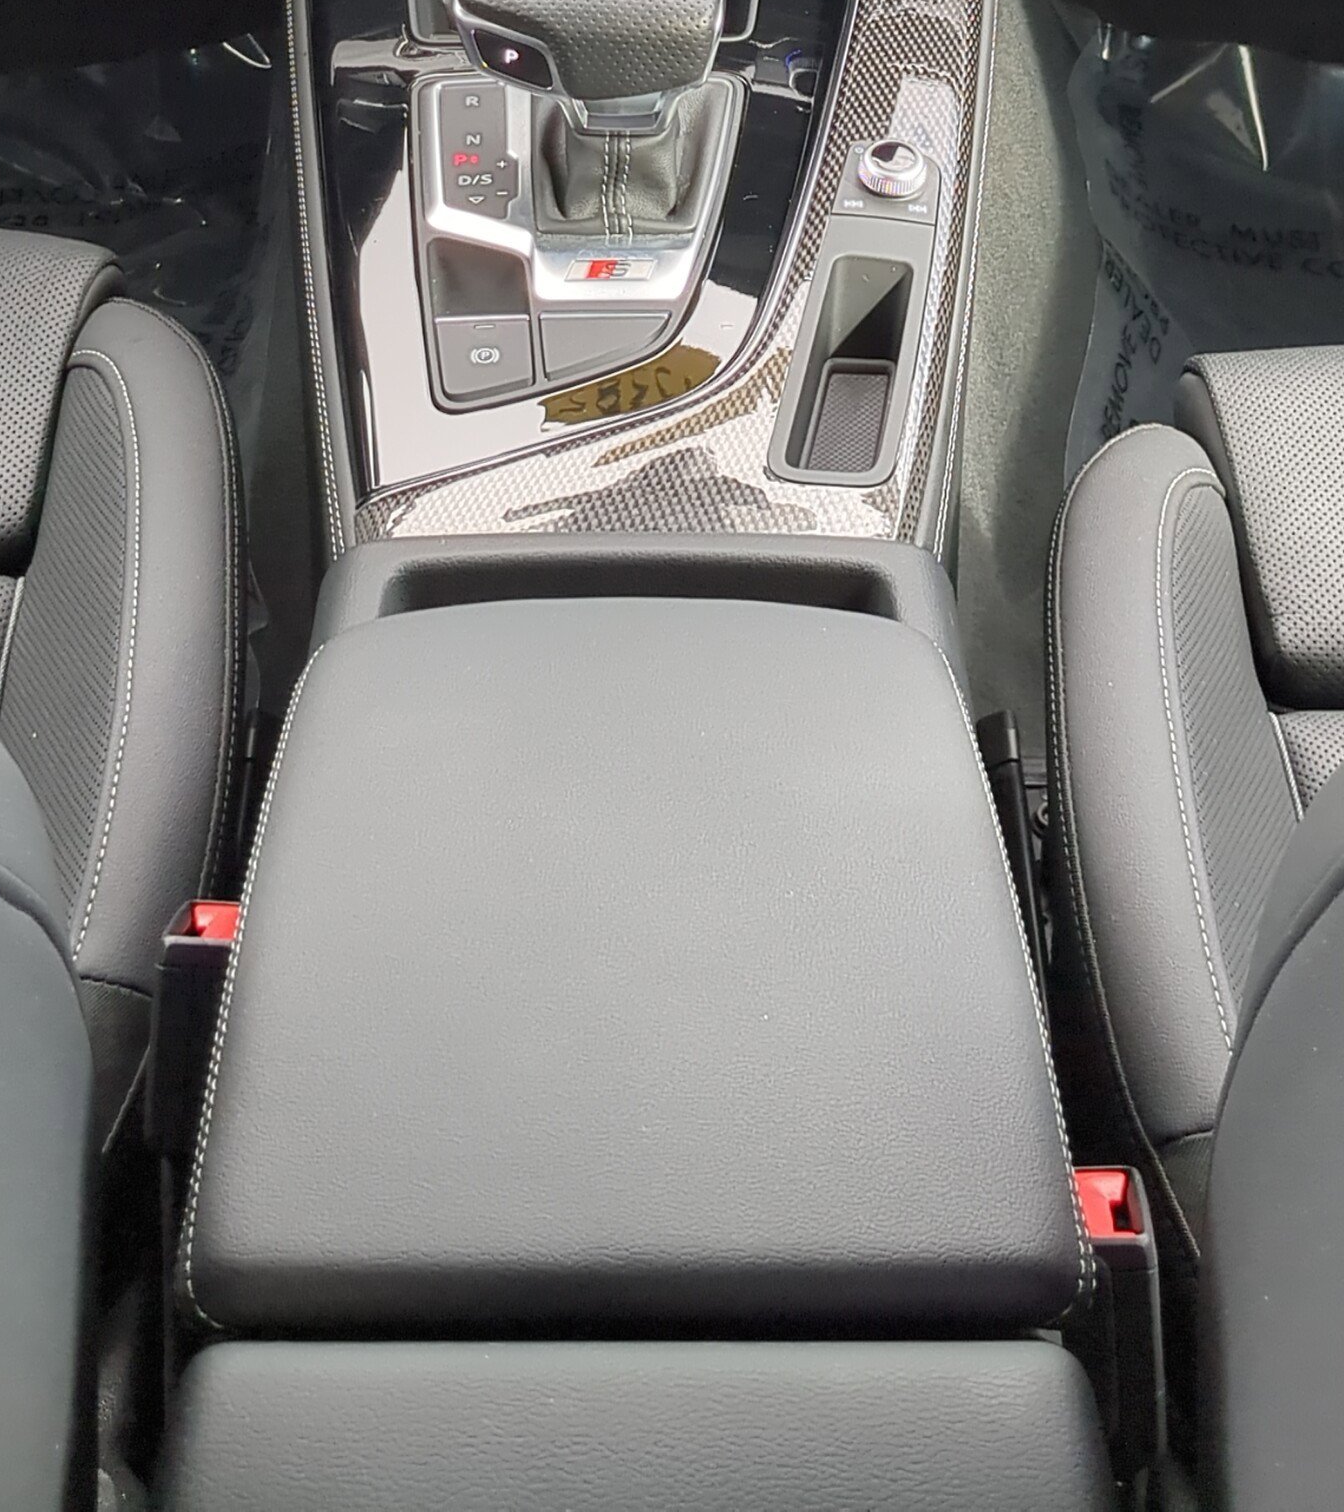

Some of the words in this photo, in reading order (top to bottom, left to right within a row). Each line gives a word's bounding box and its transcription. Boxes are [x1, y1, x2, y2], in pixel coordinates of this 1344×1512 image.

[505, 49, 519, 64] P
[465, 96, 479, 106] R
[467, 135, 481, 145] N
[458, 174, 493, 186] D/S
